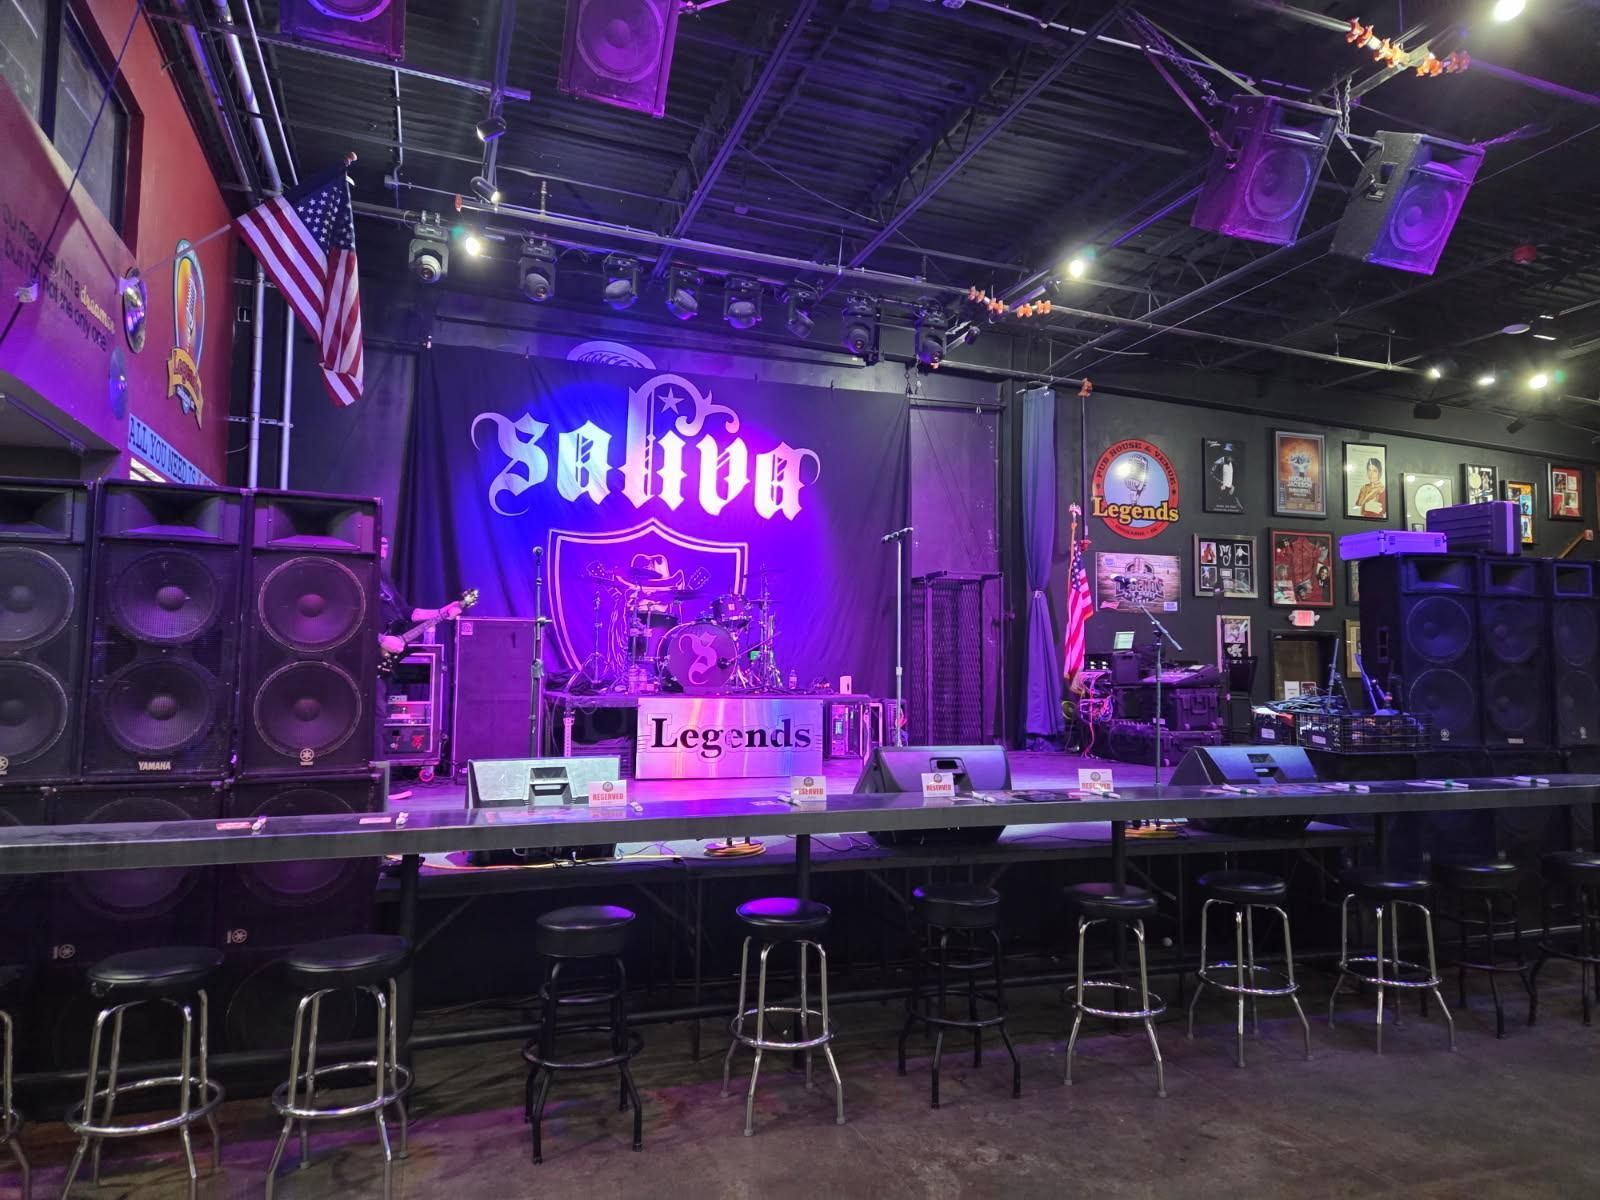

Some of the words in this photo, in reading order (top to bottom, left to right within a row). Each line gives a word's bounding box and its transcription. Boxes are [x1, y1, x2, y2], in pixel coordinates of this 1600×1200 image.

[129, 417, 147, 454] ALL
[150, 433, 167, 468] YOU
[167, 448, 187, 483] NEED
[1096, 457, 1110, 479] PUB
[1110, 441, 1142, 457] HOUSE
[1144, 445, 1152, 453] &
[1154, 450, 1178, 486] VENUE
[1091, 496, 1180, 525] Legends
[651, 717, 812, 759] Legends
[137, 760, 171, 771] YAMAHA
[592, 792, 624, 801] RESERVED
[926, 783, 952, 792] RESERVED
